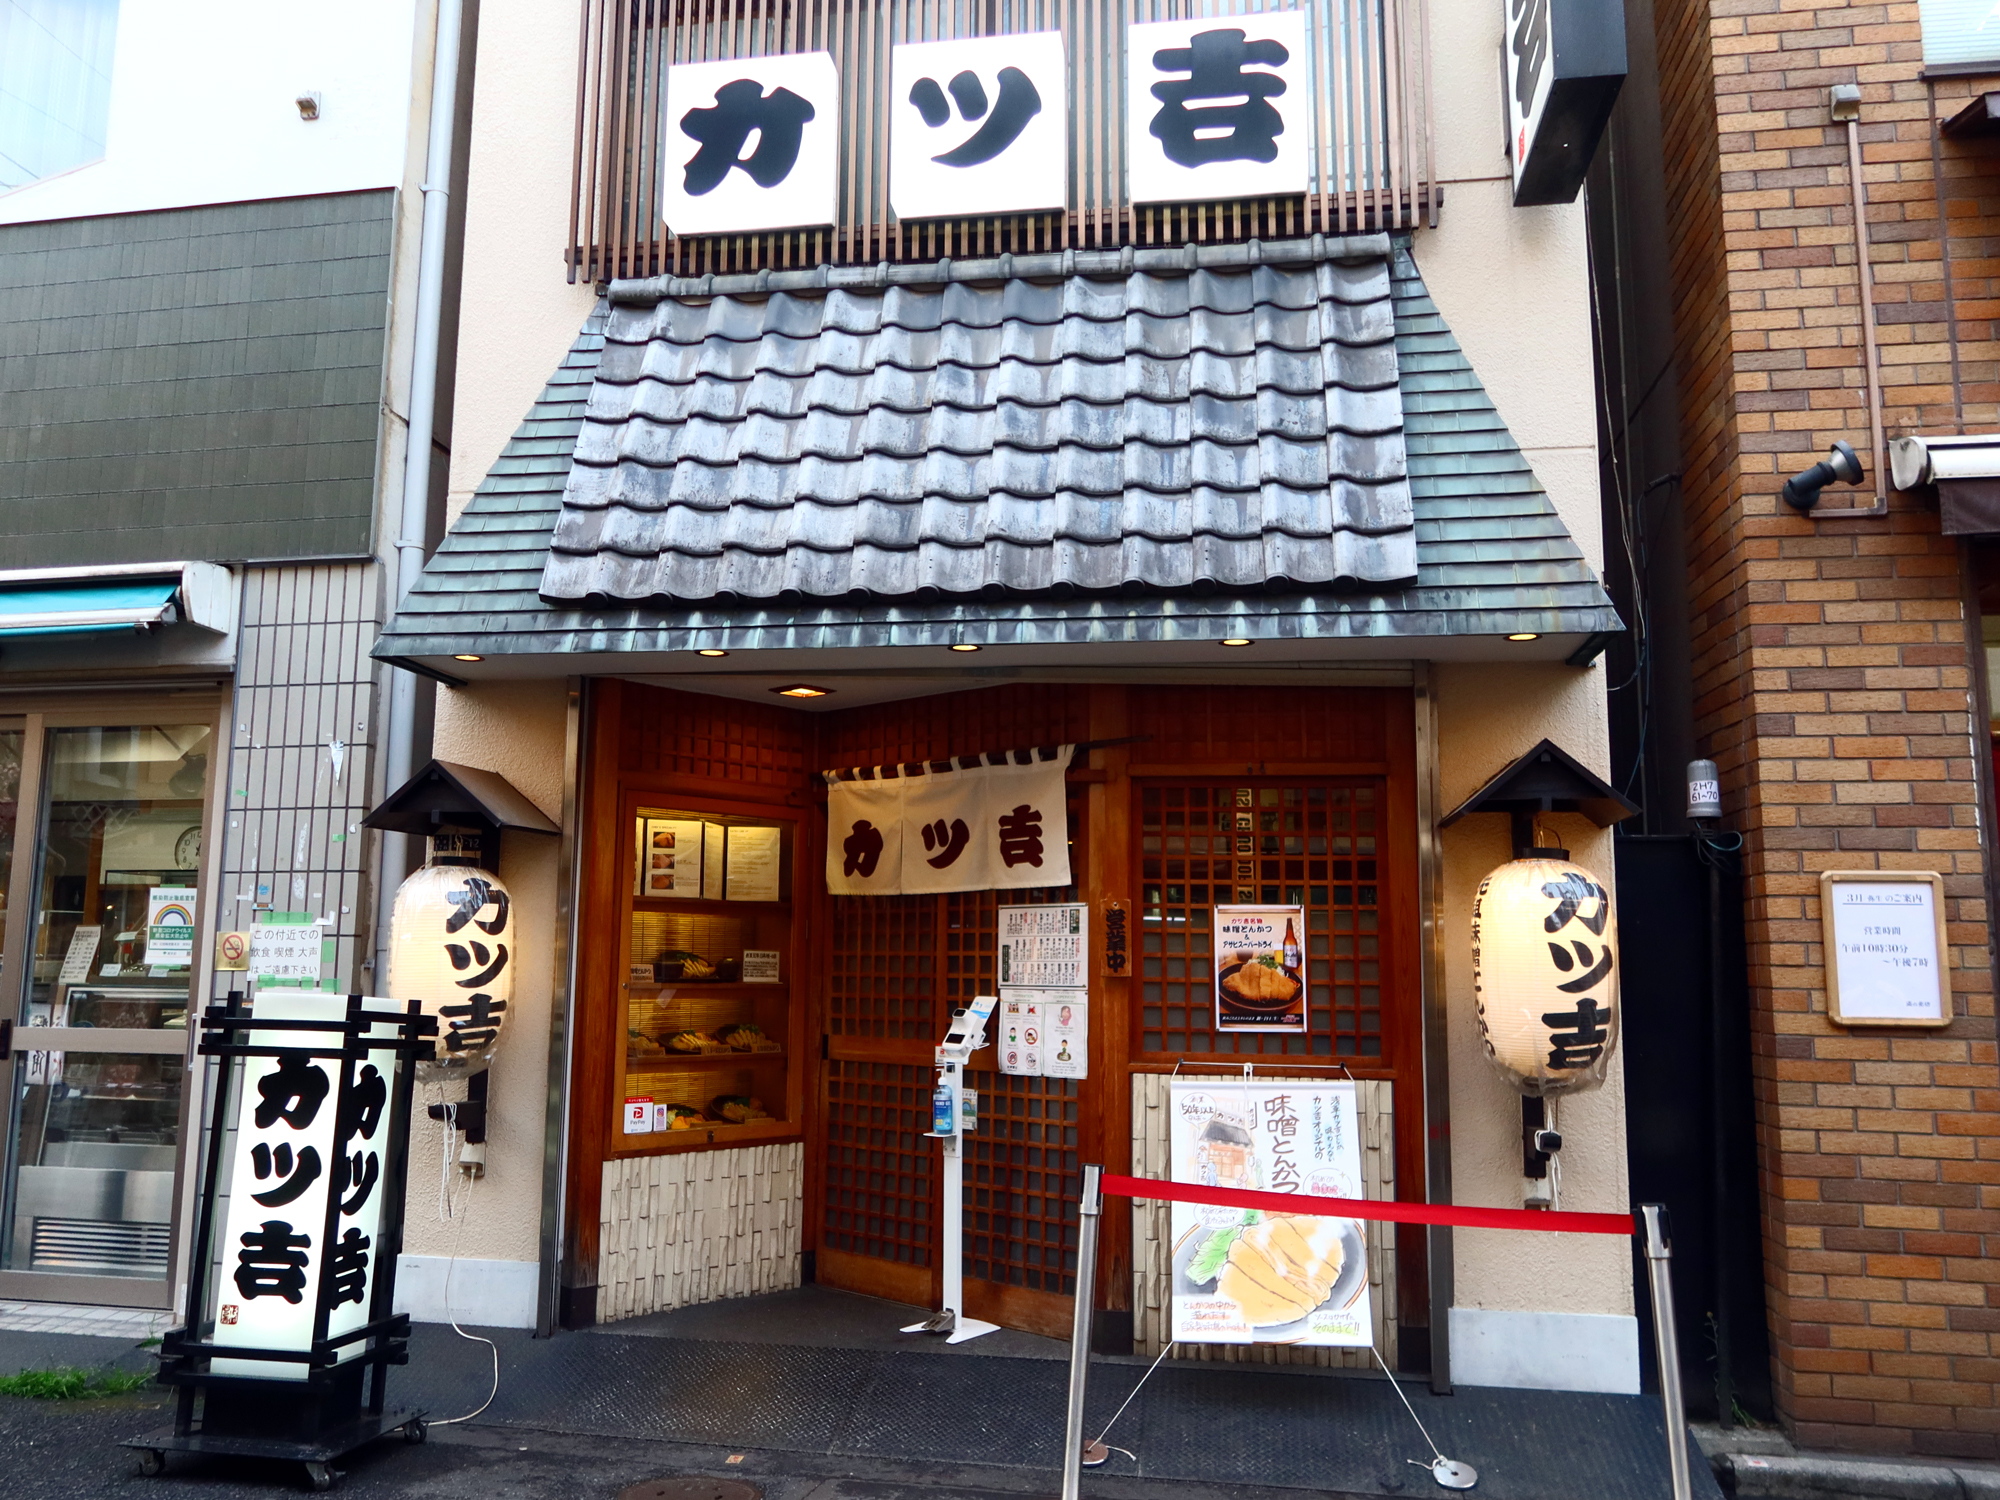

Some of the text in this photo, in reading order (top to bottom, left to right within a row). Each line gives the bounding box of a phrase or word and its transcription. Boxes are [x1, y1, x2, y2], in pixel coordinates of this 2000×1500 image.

[680, 28, 1289, 196] カツ吉
[1693, 781, 1713, 791] 2H7
[844, 805, 1044, 878] カツ吉
[250, 947, 318, 958] 飲食 喫煙 大声
[253, 929, 319, 941] この付近での
[1106, 909, 1126, 973] 営業中
[1222, 925, 1272, 933] 味噌とんかつ
[1864, 926, 1901, 935] 営業時間
[264, 965, 317, 975] ご遠慮下さい
[439, 877, 510, 1051] カツ吉
[1541, 872, 1613, 1070] カツ吉
[1181, 1101, 1214, 1114] 50年以上
[1313, 1095, 1325, 1160] カツ吉オリジナルの
[1265, 1094, 1301, 1194] 味噌とんかつ
[234, 1056, 330, 1304] カツ吉
[330, 1064, 387, 1310] カツ吉
[1312, 1321, 1360, 1336] そのままで!!
